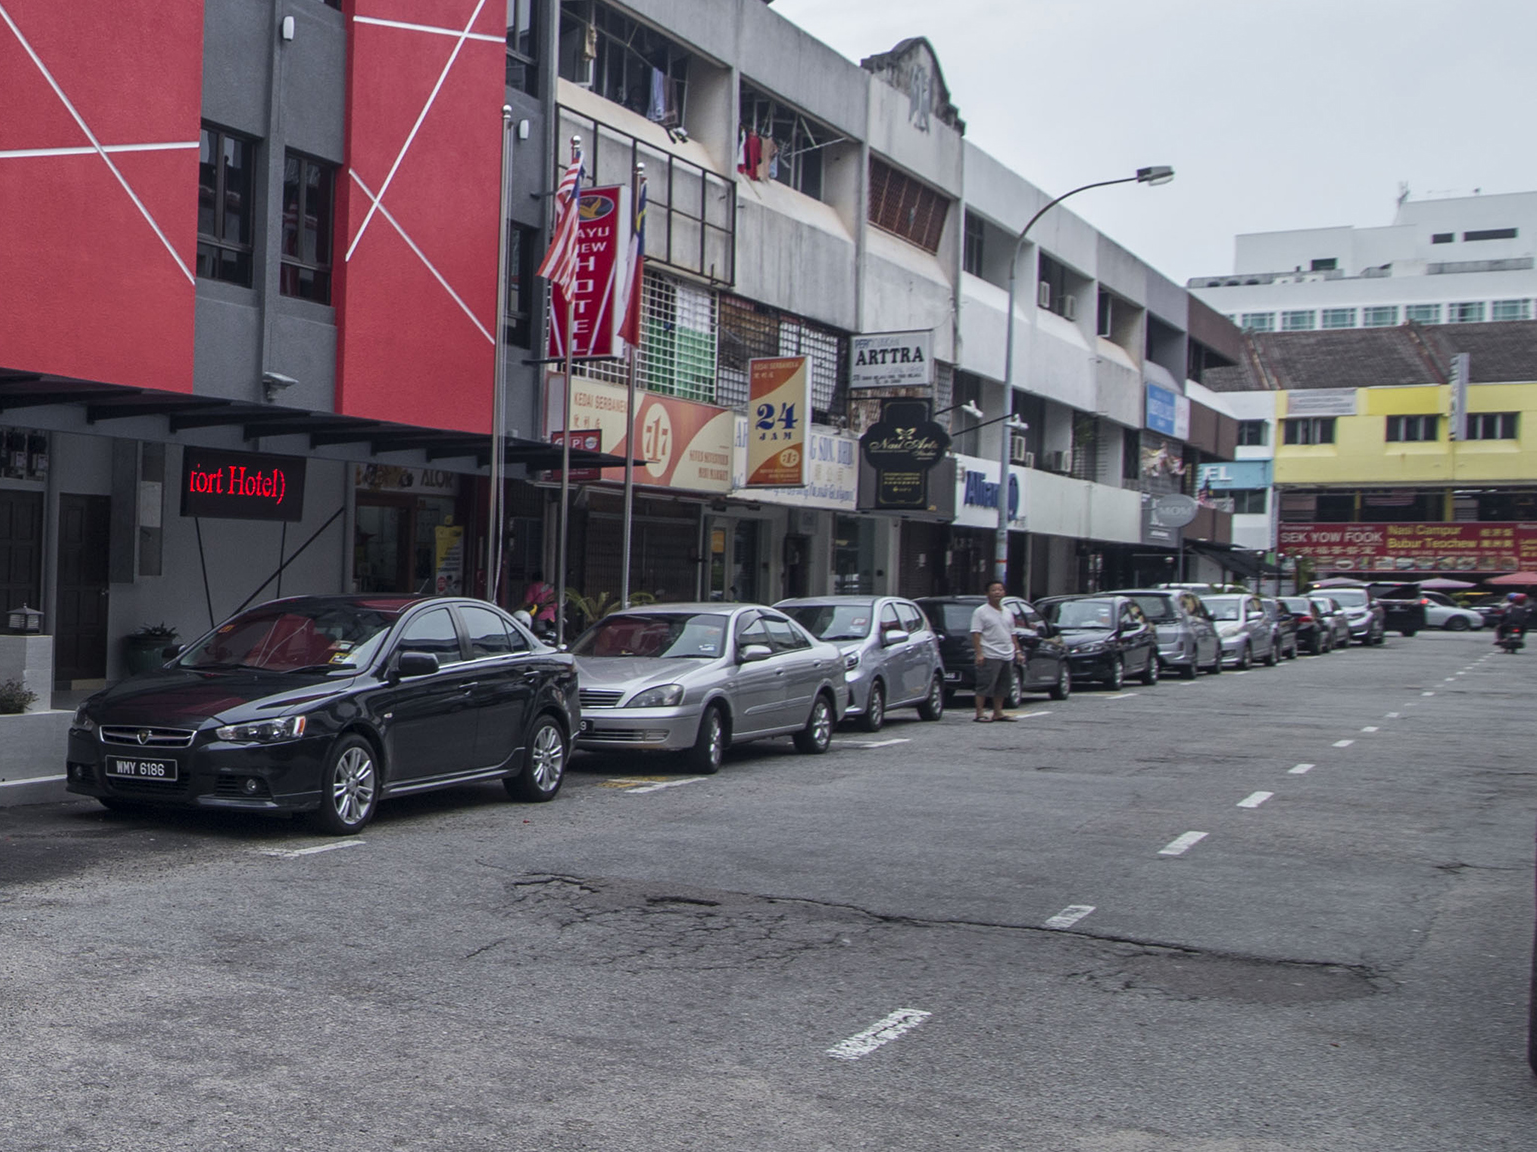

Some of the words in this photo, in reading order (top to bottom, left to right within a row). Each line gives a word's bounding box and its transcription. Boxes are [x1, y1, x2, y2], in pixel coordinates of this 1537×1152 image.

[577, 226, 610, 238] AYU
[576, 241, 607, 253] IEW
[573, 256, 595, 352] HOTEL
[855, 346, 924, 366] ARTTRA
[595, 395, 628, 414] SERBANE
[755, 402, 798, 430] 24
[759, 432, 792, 441] JAM
[227, 465, 286, 505] Hotel)
[1280, 532, 1308, 543] SEK
[1310, 532, 1342, 542] YOW
[1344, 532, 1383, 542] FOOK
[1415, 525, 1463, 536] Campur
[116, 760, 136, 774] WMY
[139, 762, 165, 776] 6186
